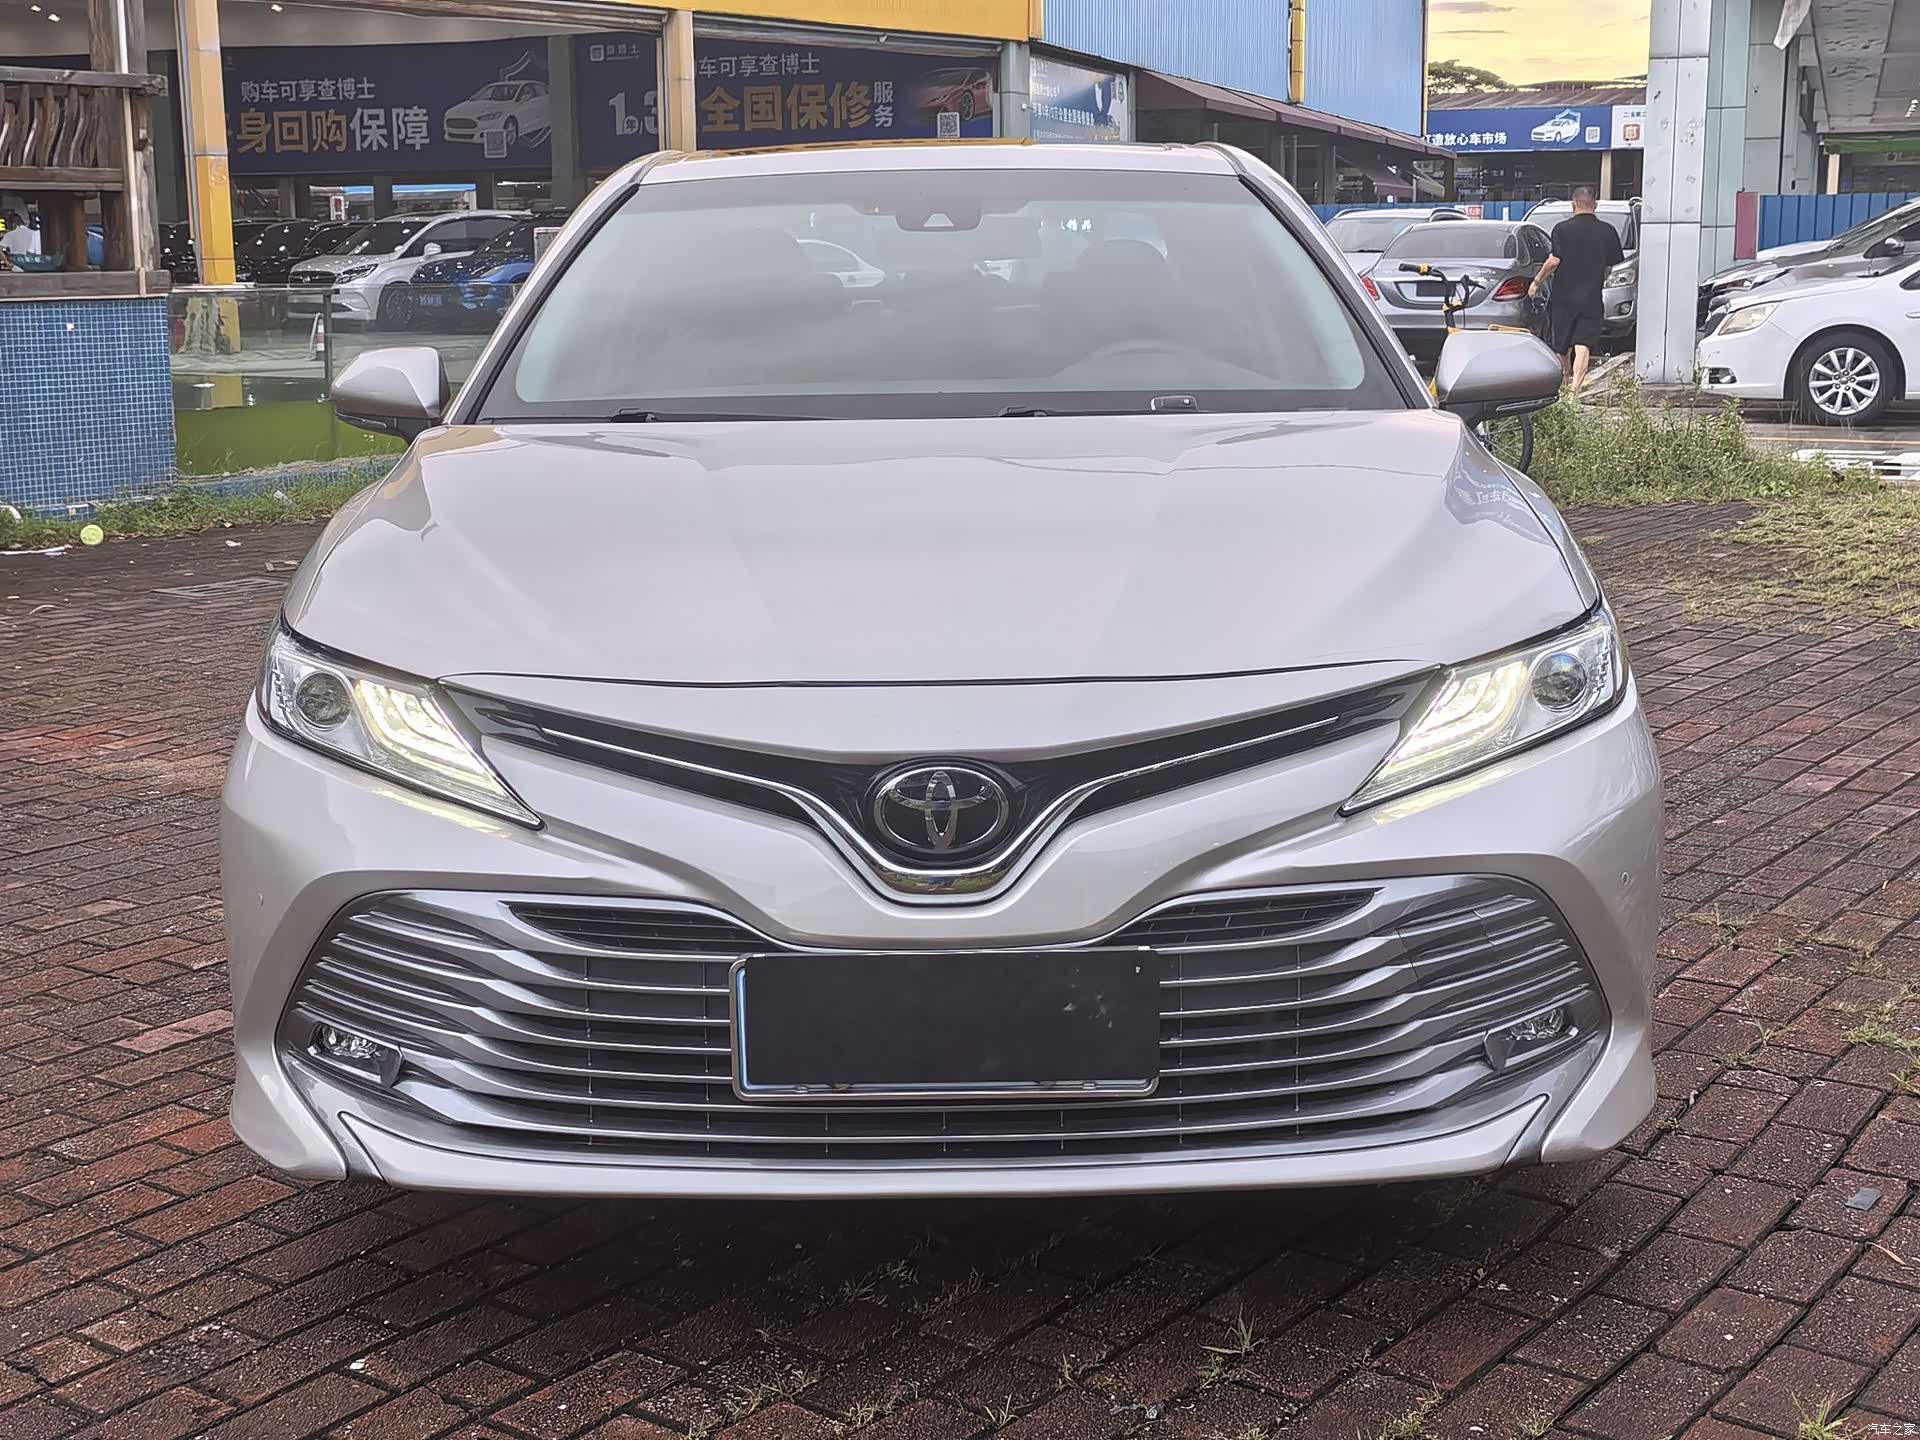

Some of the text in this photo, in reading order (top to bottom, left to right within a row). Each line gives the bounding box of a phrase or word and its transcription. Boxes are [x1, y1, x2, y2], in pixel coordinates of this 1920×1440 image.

[699, 52, 820, 78] 车可享查博士
[240, 77, 375, 103] 购车可享查博士
[701, 81, 872, 133] 全国保修
[874, 81, 894, 127] 服务
[237, 105, 431, 154] 身回购保障
